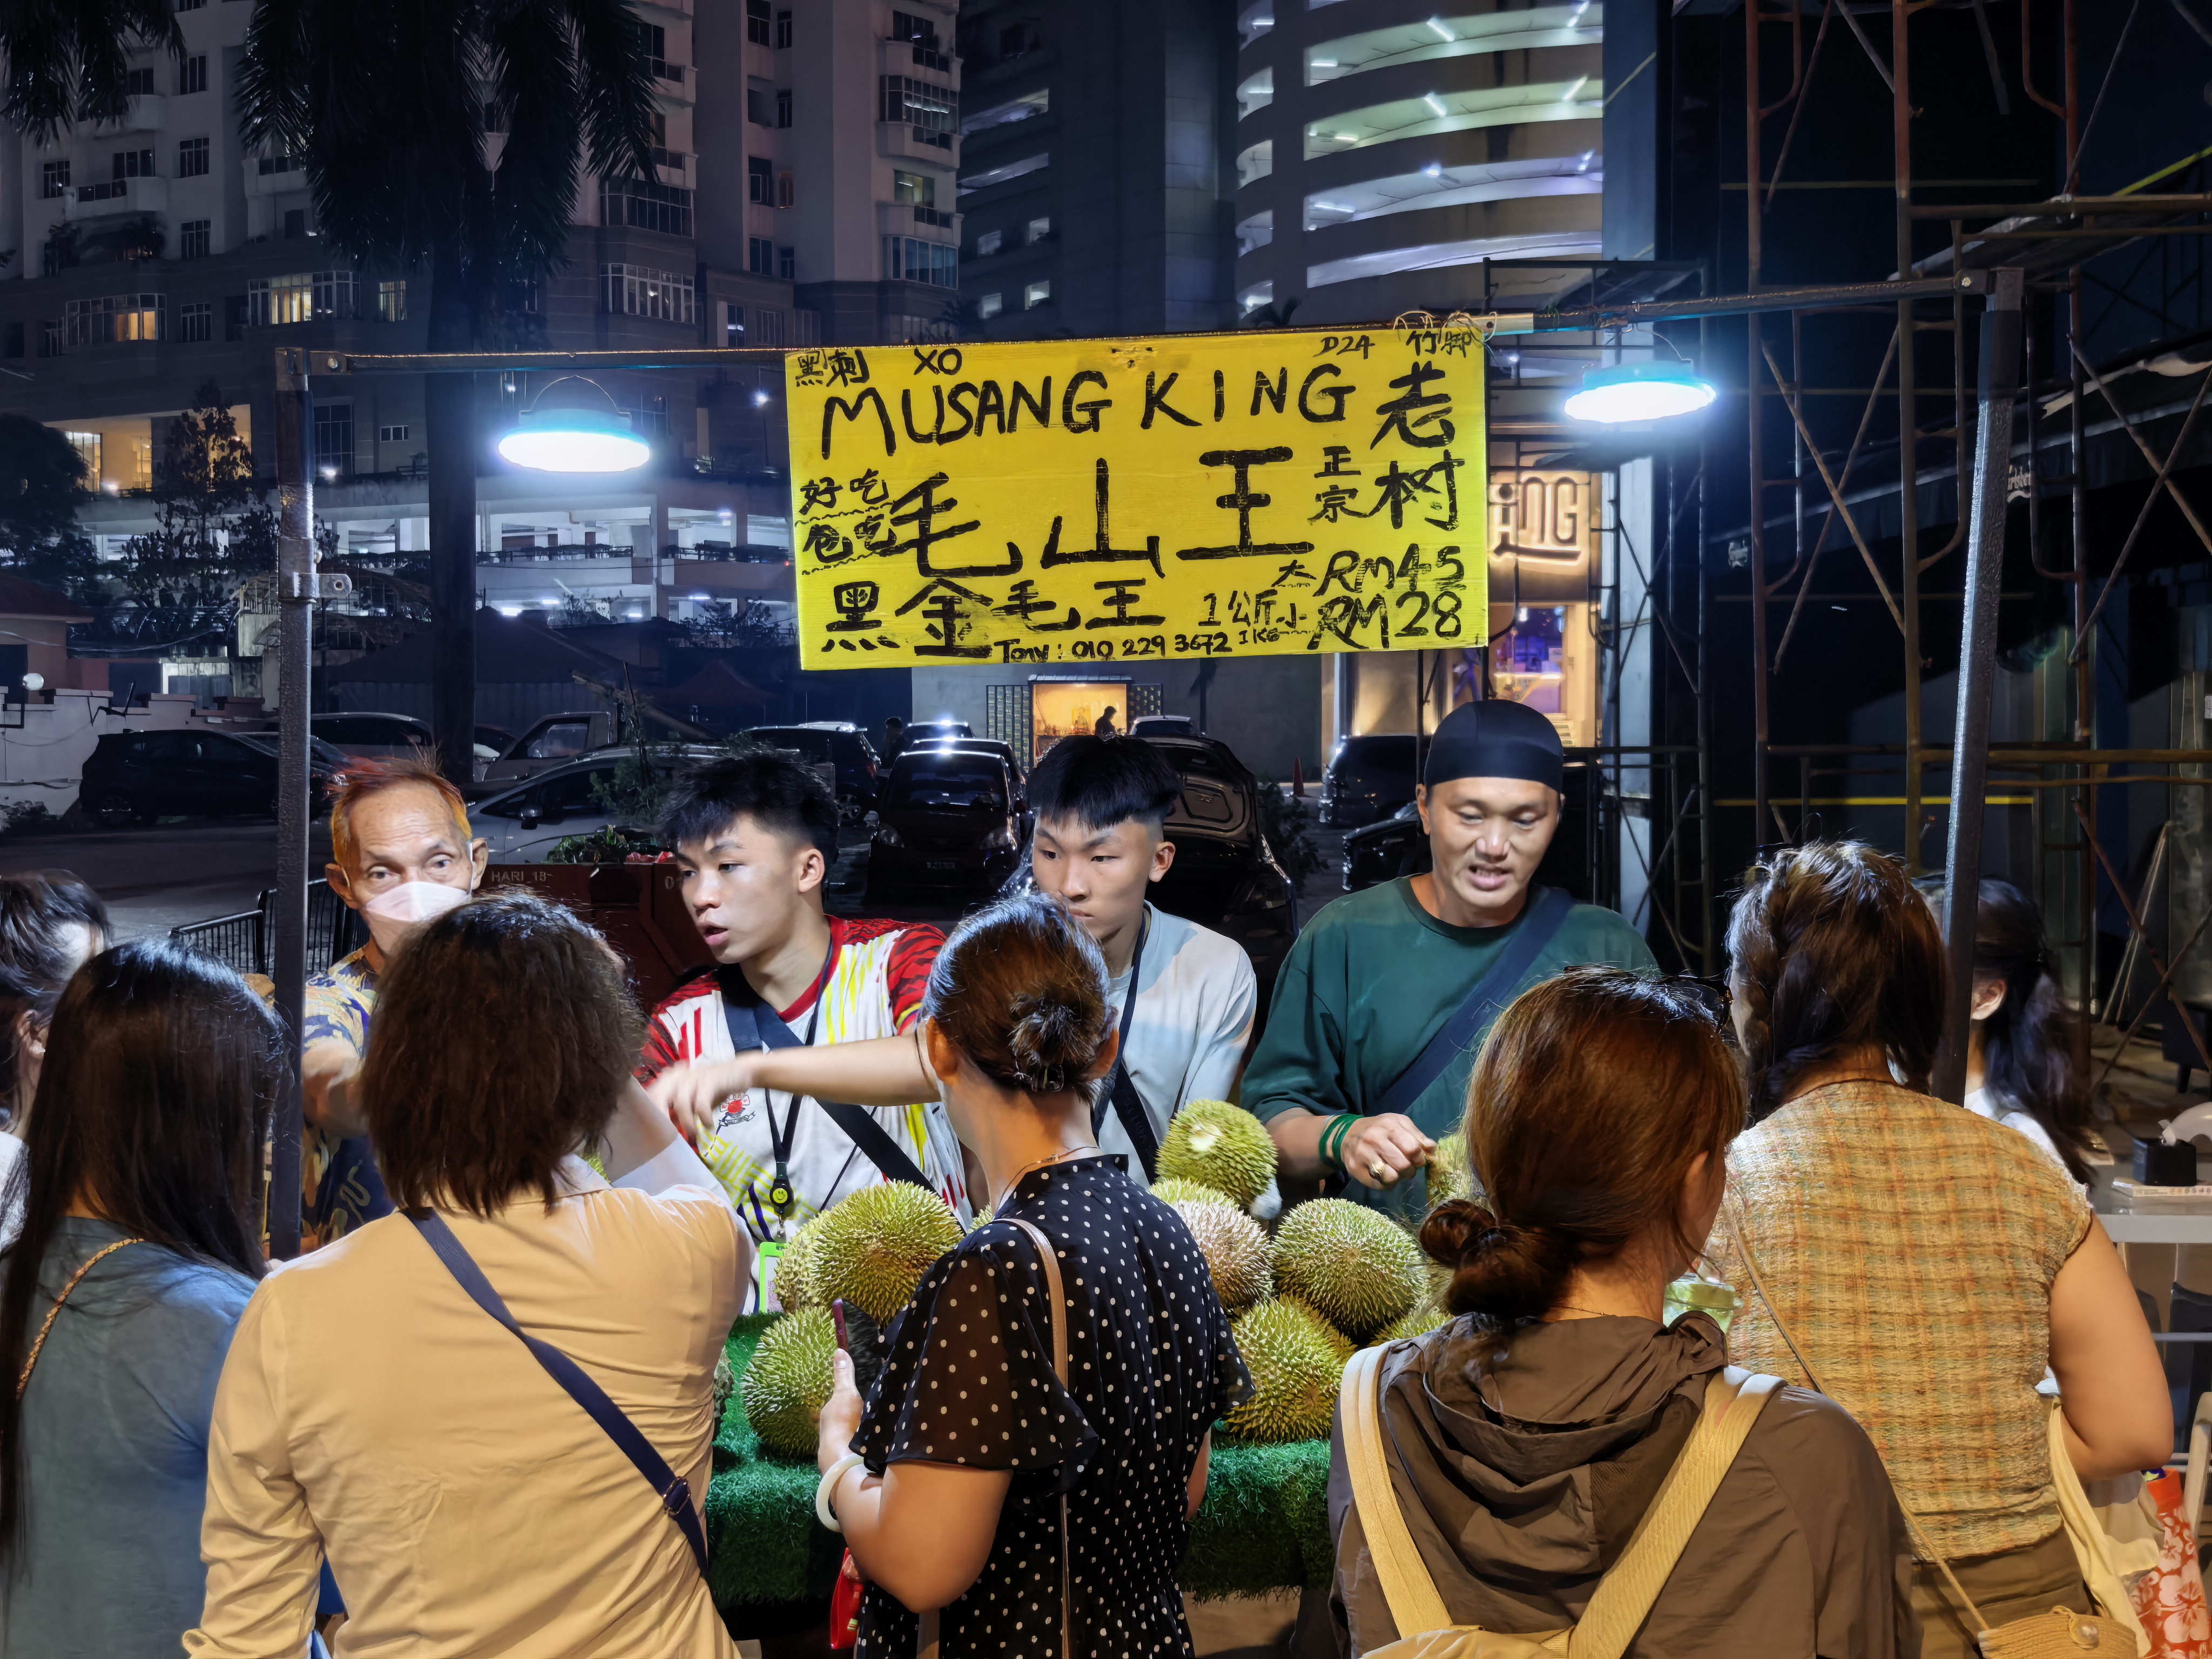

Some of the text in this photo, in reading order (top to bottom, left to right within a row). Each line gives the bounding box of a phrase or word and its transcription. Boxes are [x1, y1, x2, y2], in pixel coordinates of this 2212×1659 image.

[913, 347, 962, 375] XO
[1312, 335, 1375, 360] D24
[821, 363, 1357, 461] MUSANG KING
[799, 468, 889, 515] 好吃
[1271, 559, 1317, 588] 大
[821, 577, 1166, 658] 黑金毛王
[1122, 635, 1165, 657] 229
[1175, 631, 1233, 655] 3672
